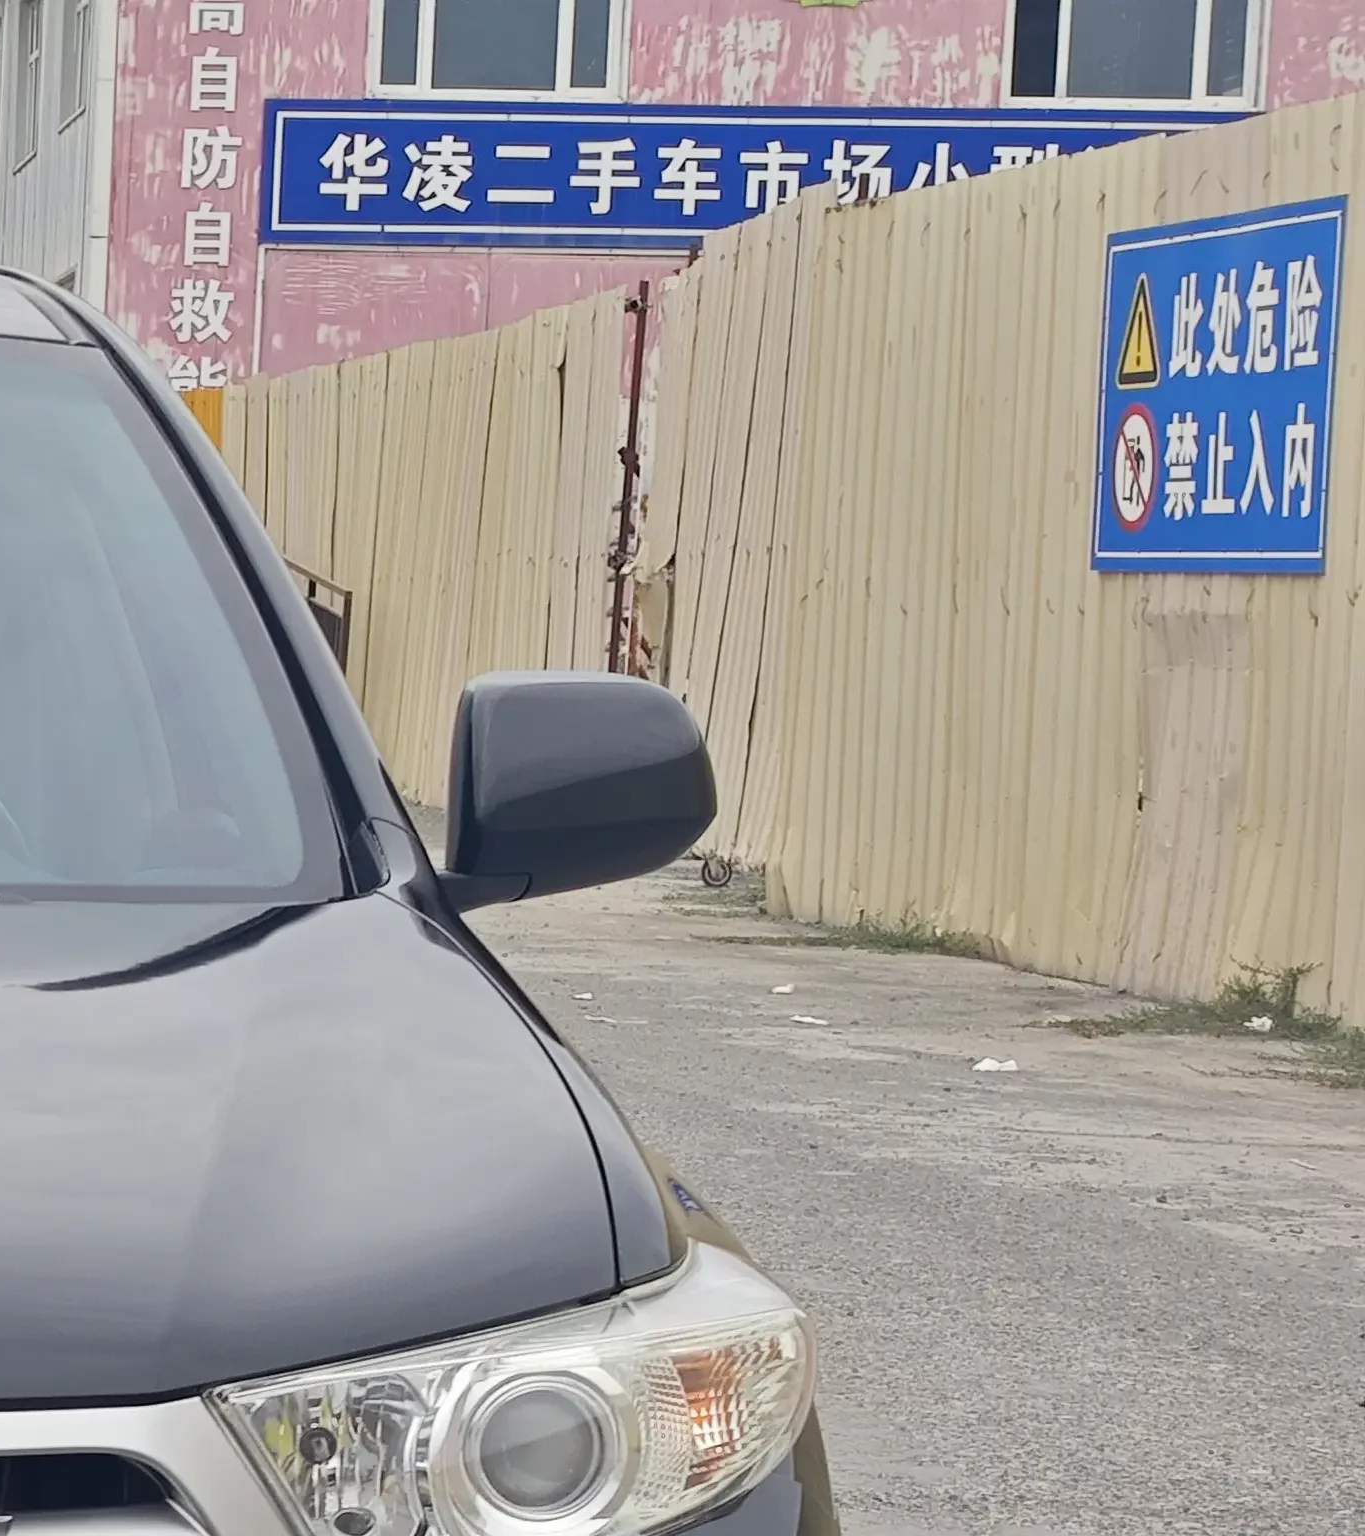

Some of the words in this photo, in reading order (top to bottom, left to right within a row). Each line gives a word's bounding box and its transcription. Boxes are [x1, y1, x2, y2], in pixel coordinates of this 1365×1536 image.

[319, 132, 1101, 217] 华凌二手车市场小
[1168, 254, 1324, 380] 此处危险
[1162, 402, 1316, 521] 禁止入内
